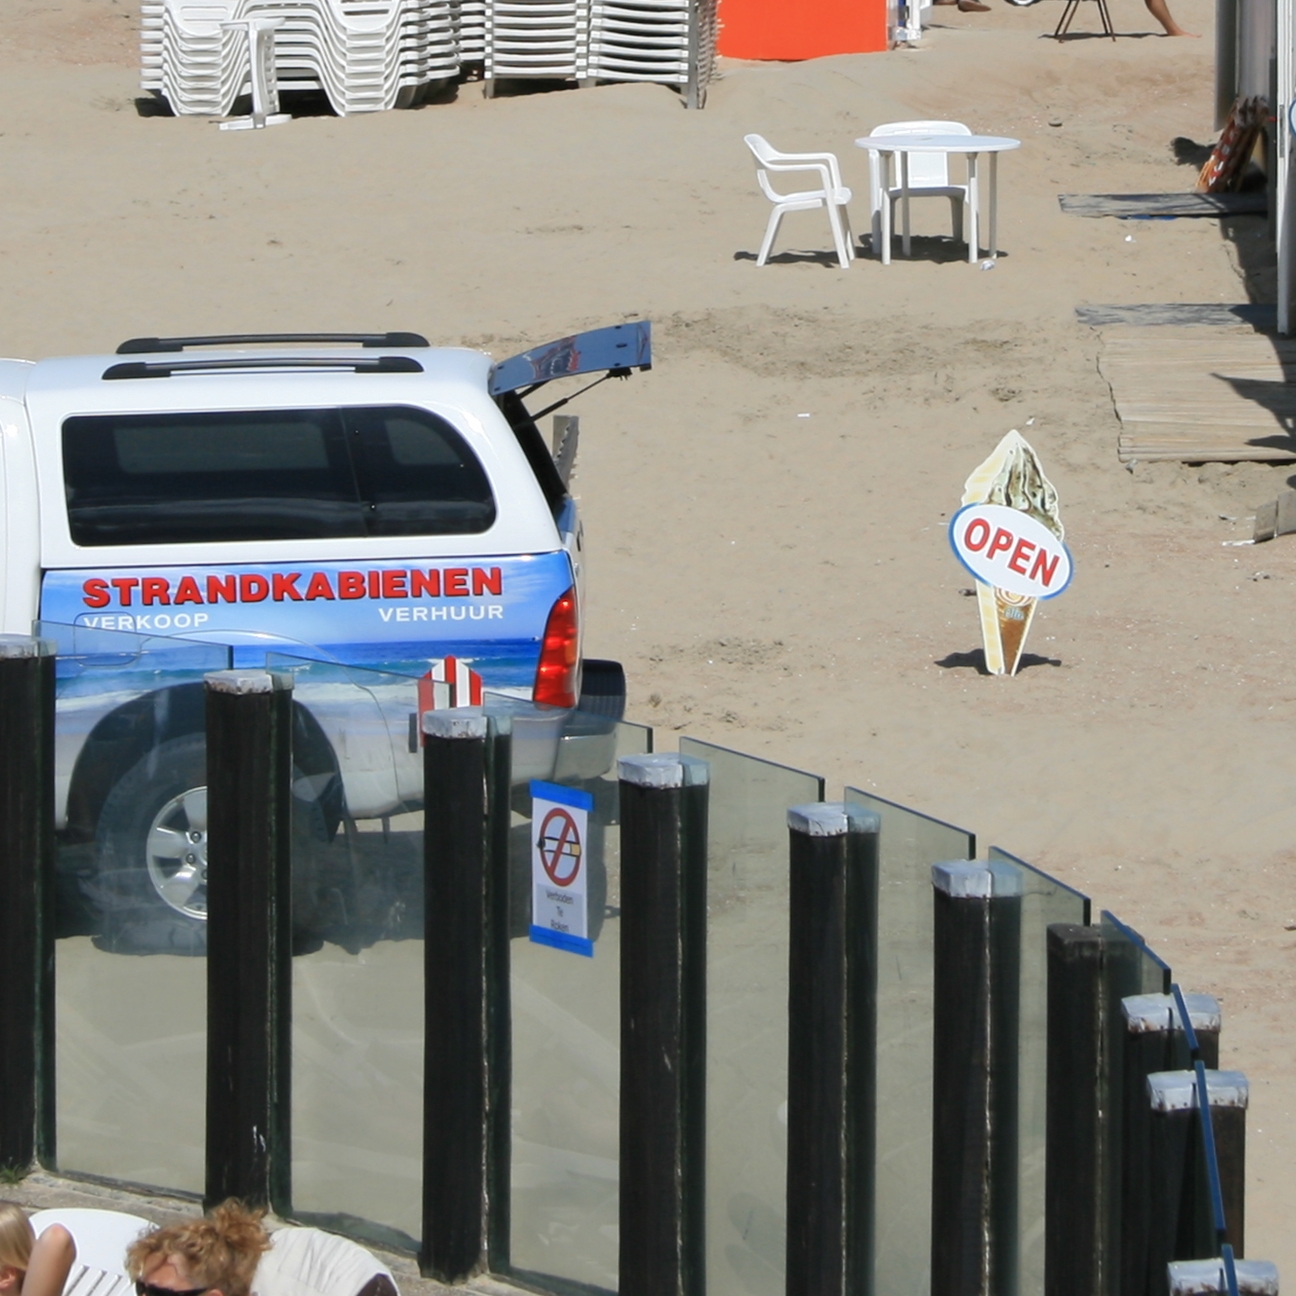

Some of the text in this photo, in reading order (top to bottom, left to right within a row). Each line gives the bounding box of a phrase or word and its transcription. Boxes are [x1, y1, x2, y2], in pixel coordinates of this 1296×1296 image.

[964, 517, 1060, 587] OPEN
[82, 567, 503, 609] STRANDKABIENEN
[84, 604, 504, 631] VERKOOP VERHUUR
[545, 889, 574, 905] Verboden
[550, 919, 570, 932] Roken
